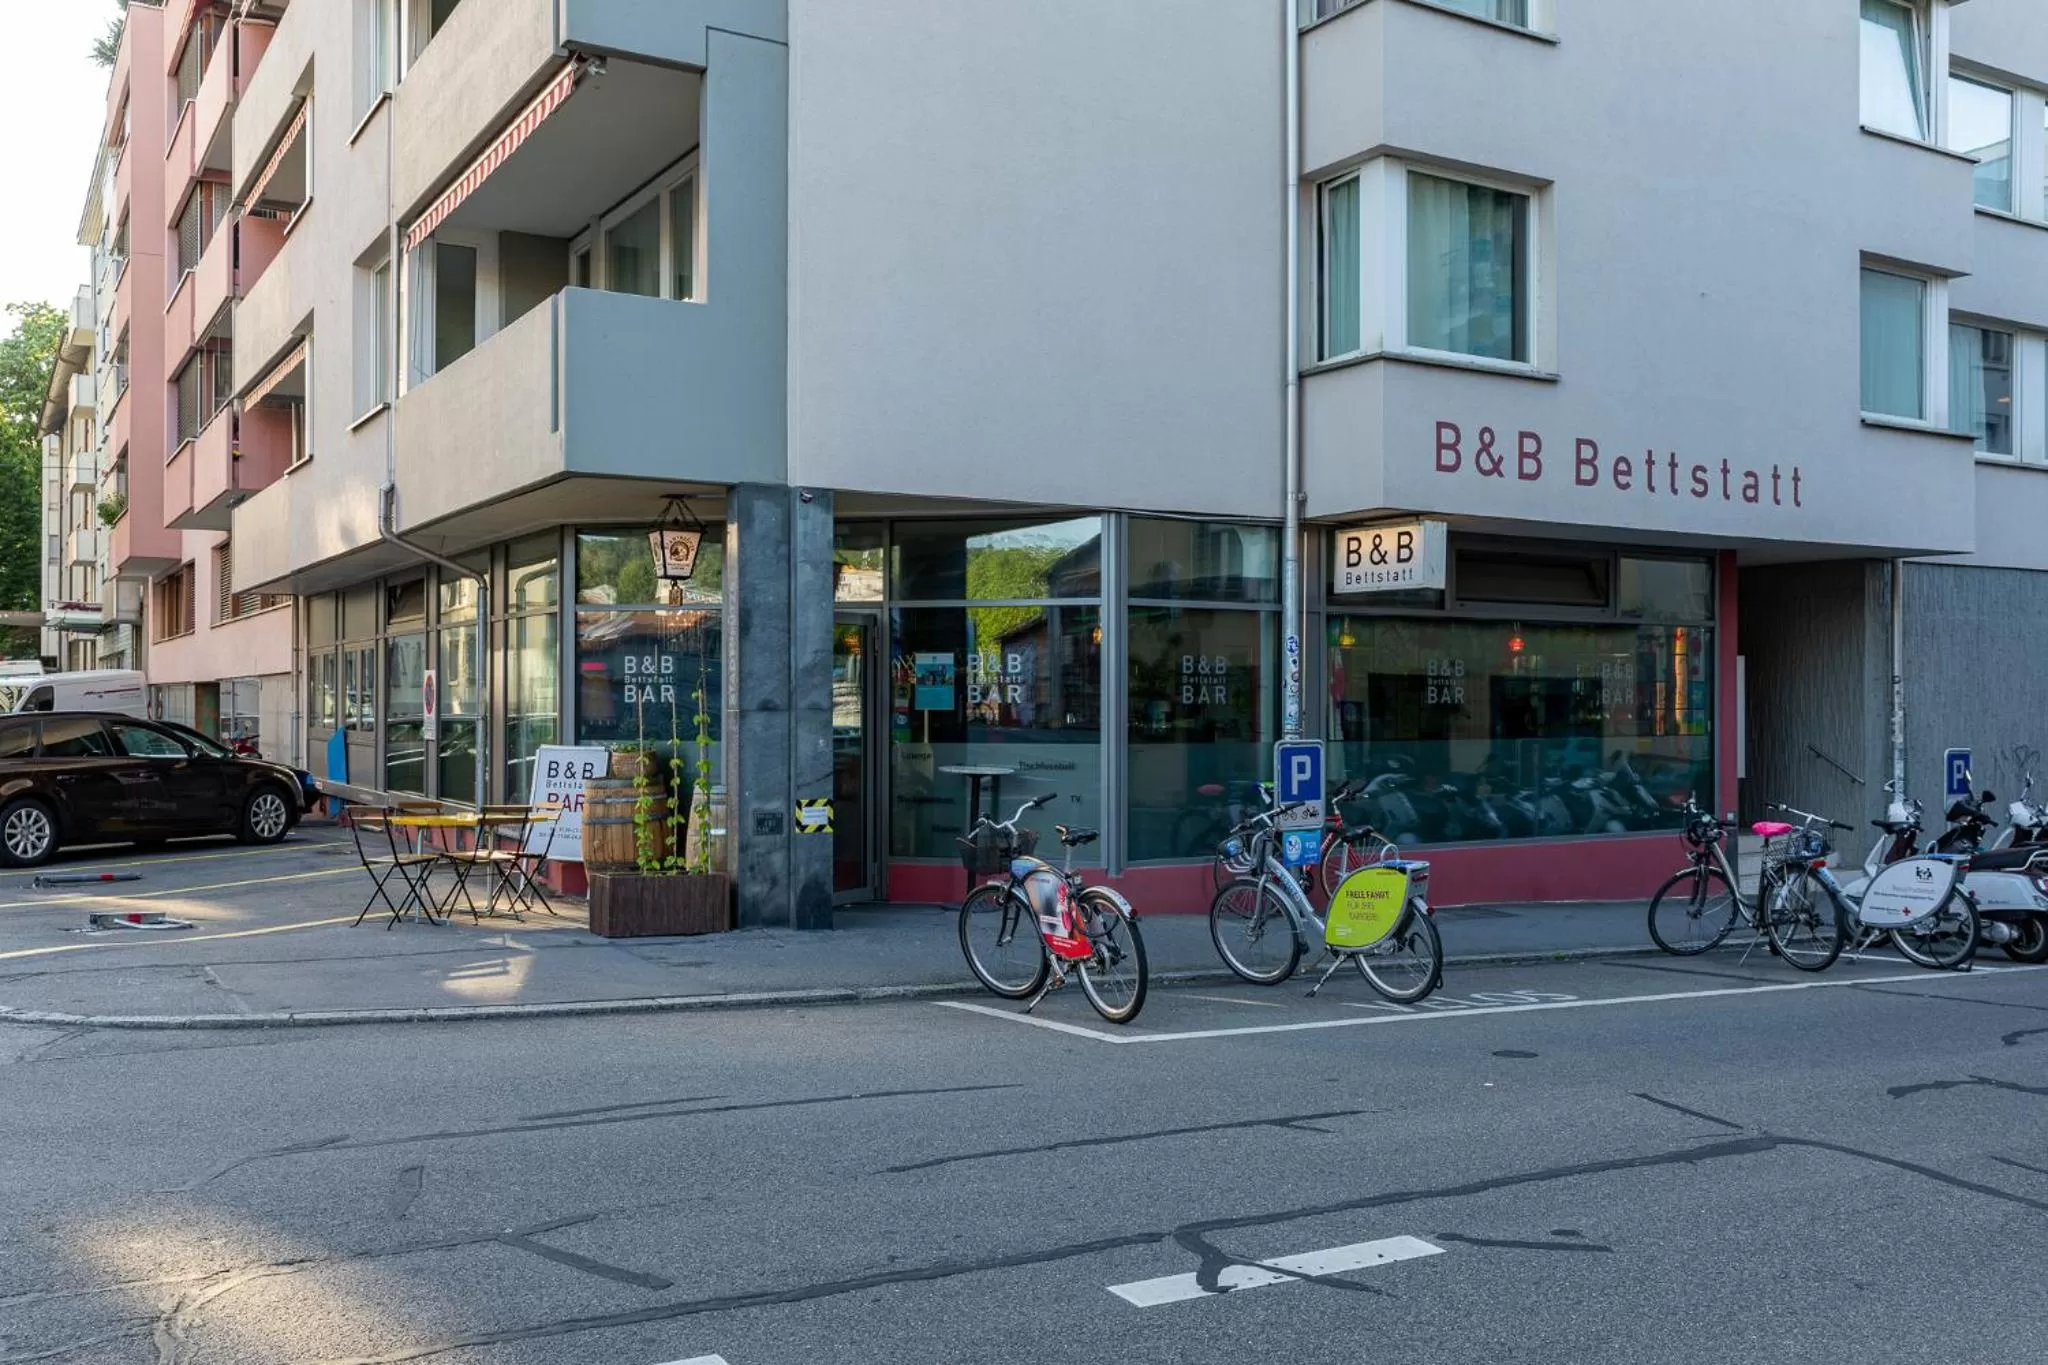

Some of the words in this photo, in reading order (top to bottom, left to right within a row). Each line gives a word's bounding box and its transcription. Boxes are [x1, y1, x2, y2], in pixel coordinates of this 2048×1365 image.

[1435, 420, 1543, 481] B&B
[1575, 437, 1802, 508] Bettstatt
[1345, 530, 1414, 569] B&B
[1345, 567, 1413, 585] Bettstatt
[624, 655, 674, 674] B&B
[967, 653, 1022, 673] B&B
[1182, 654, 1228, 675] B&B
[1427, 659, 1465, 677] B&B
[624, 684, 675, 703] BAR
[967, 685, 1022, 703] BAR
[1182, 685, 1227, 705] BAR
[1427, 686, 1465, 705] BAR
[546, 760, 595, 780] B&B
[1291, 755, 1311, 796] P
[1953, 759, 1965, 790] P
[545, 780, 583, 789] Bettsta
